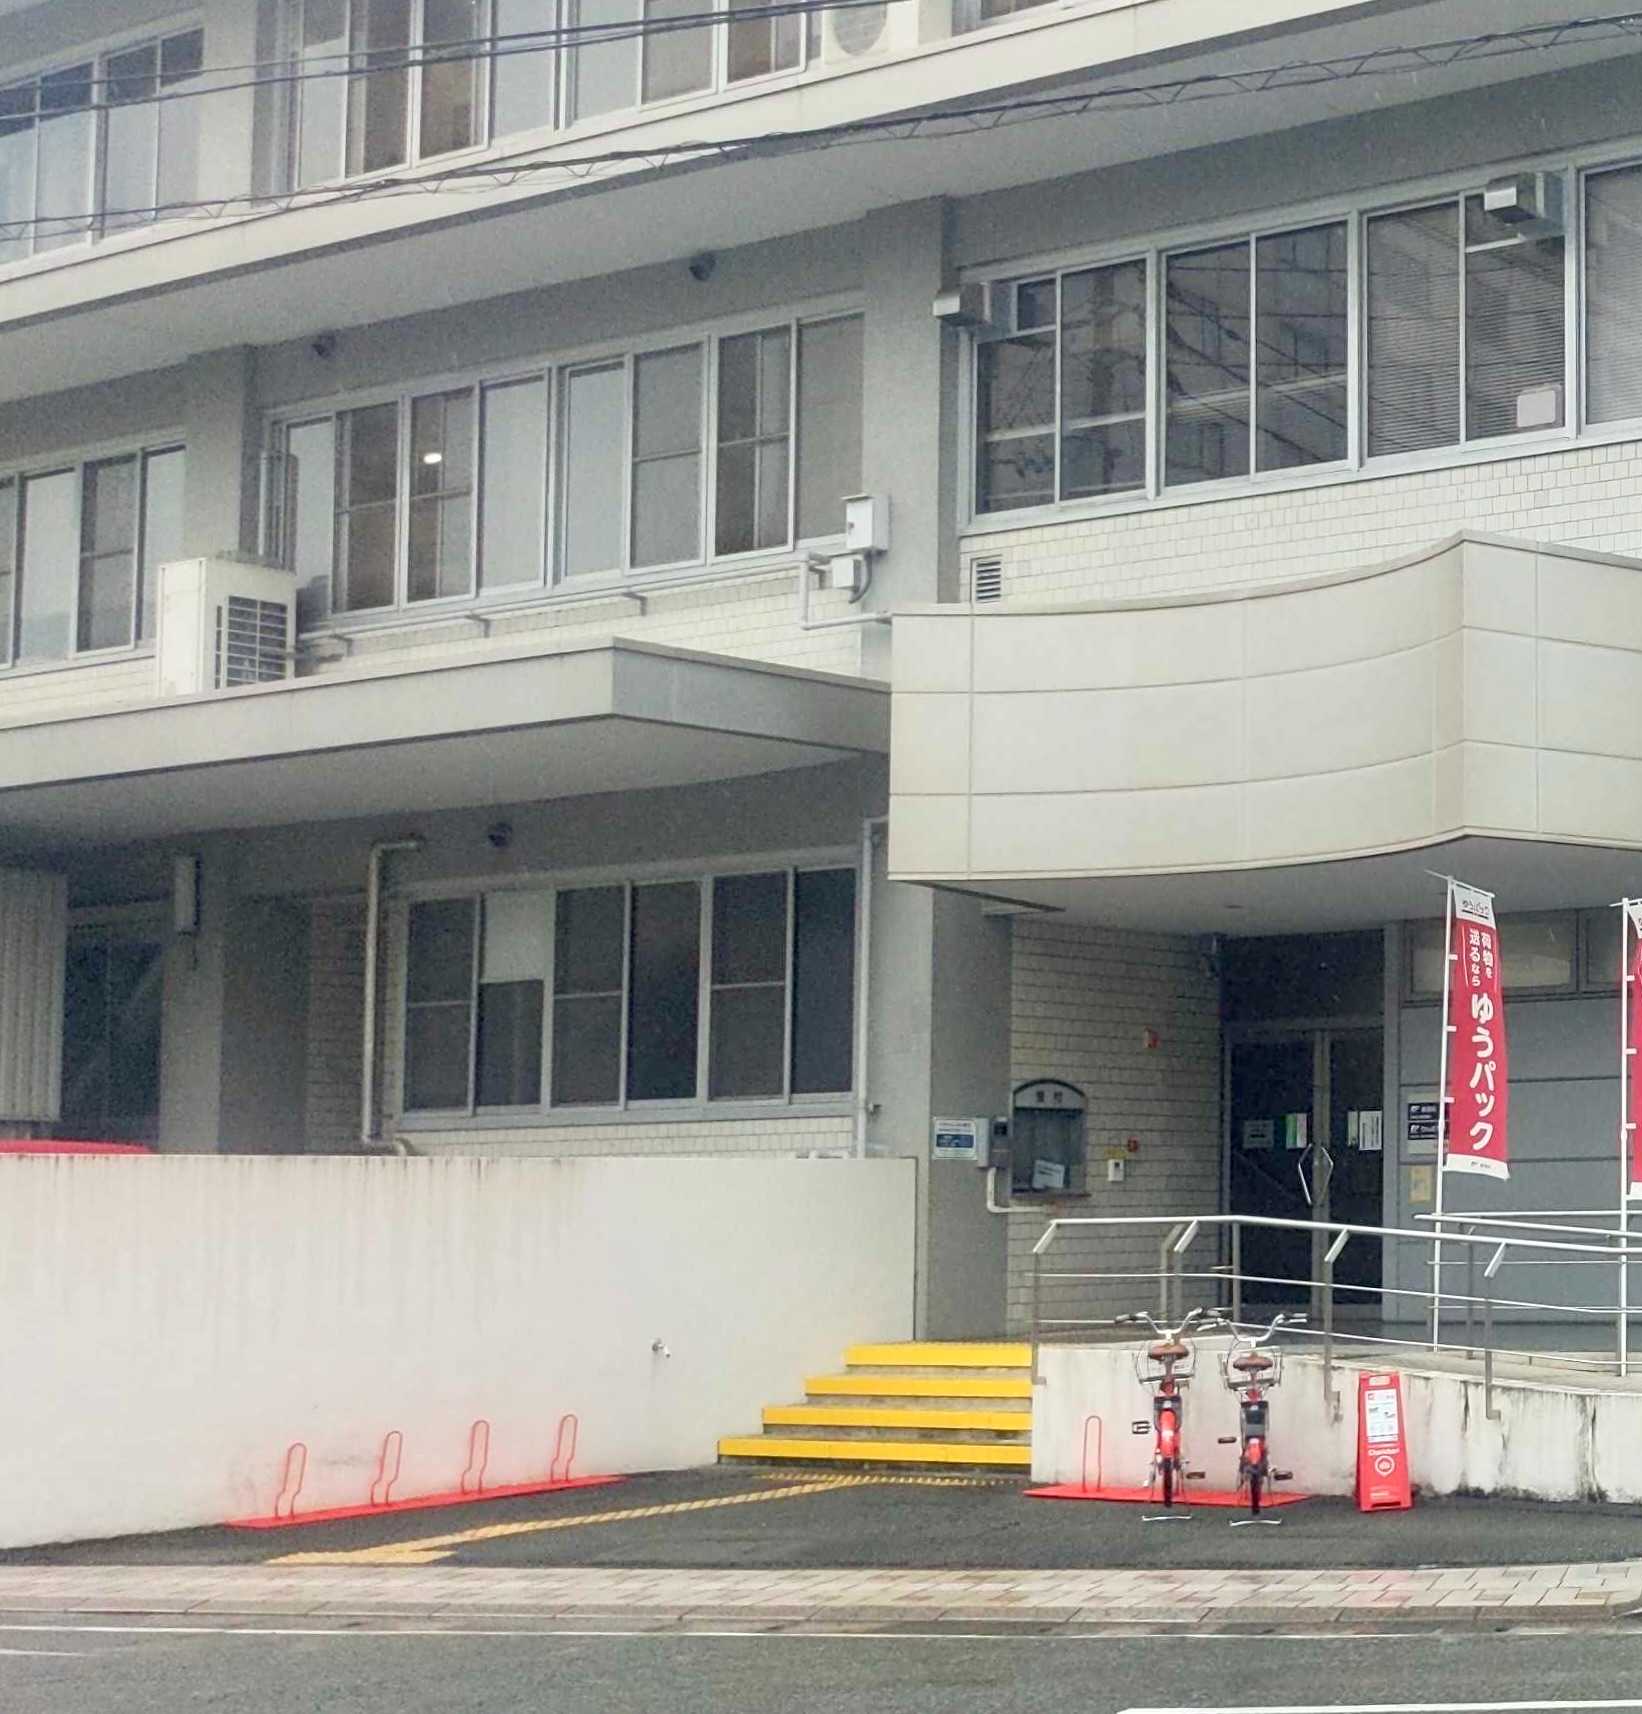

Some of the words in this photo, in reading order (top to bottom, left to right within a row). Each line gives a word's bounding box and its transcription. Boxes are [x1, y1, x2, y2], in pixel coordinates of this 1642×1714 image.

[1469, 993, 1497, 1151] ゆうパック
